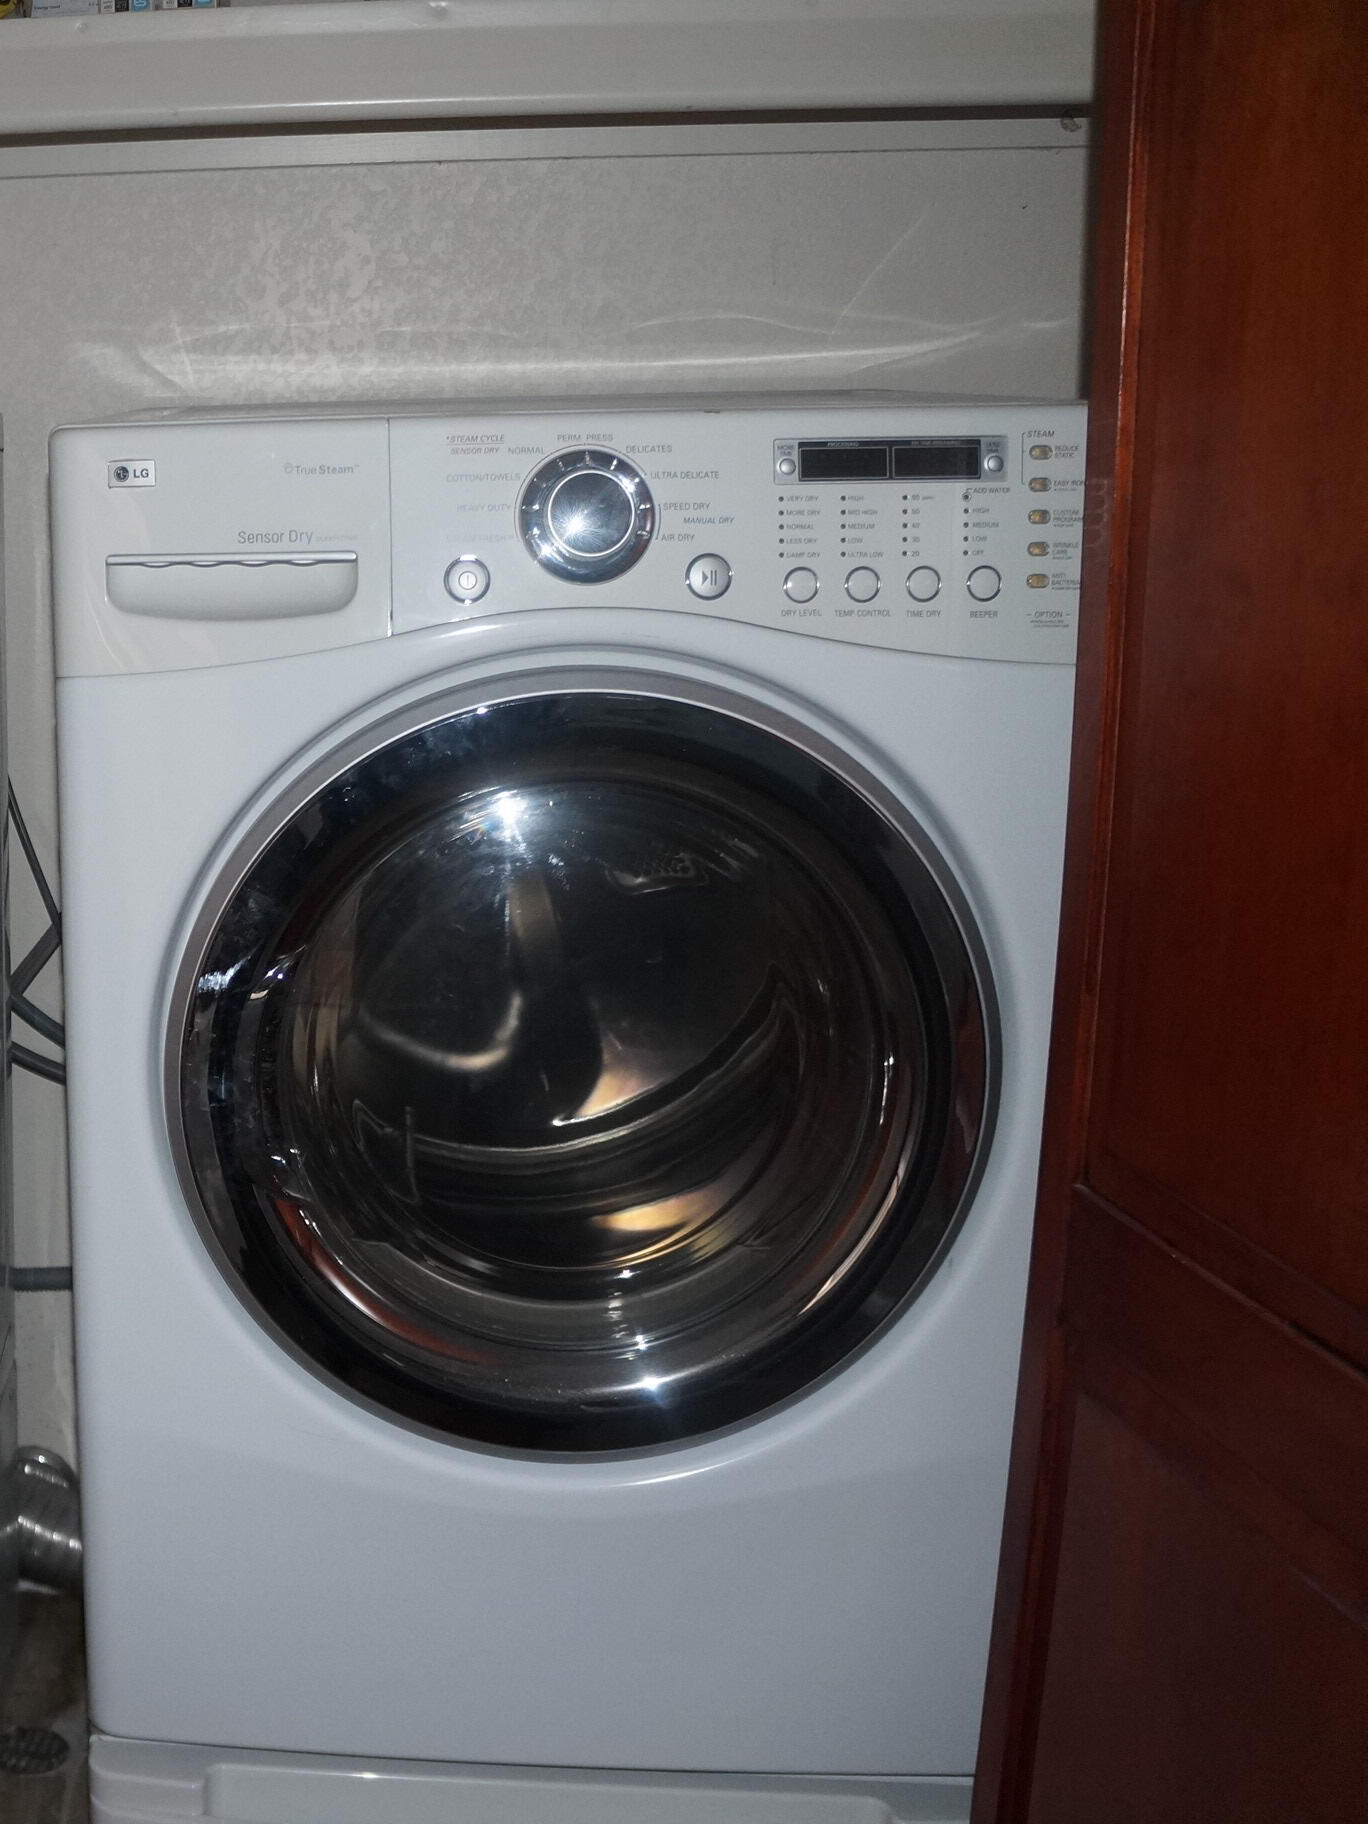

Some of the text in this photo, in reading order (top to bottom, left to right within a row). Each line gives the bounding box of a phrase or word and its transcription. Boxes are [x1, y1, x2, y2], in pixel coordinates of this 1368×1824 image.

[480, 434, 504, 442] CYCLE
[1027, 430, 1054, 438] STEAM
[450, 447, 482, 455] SENSOR
[508, 446, 544, 454] NORMAL
[133, 468, 149, 478] LG
[238, 530, 284, 544] Sensor
[288, 530, 314, 544] Dry
[661, 534, 695, 542] AIR DRY
[906, 610, 941, 618] TIME DRY
[970, 610, 998, 618] BEEPER
